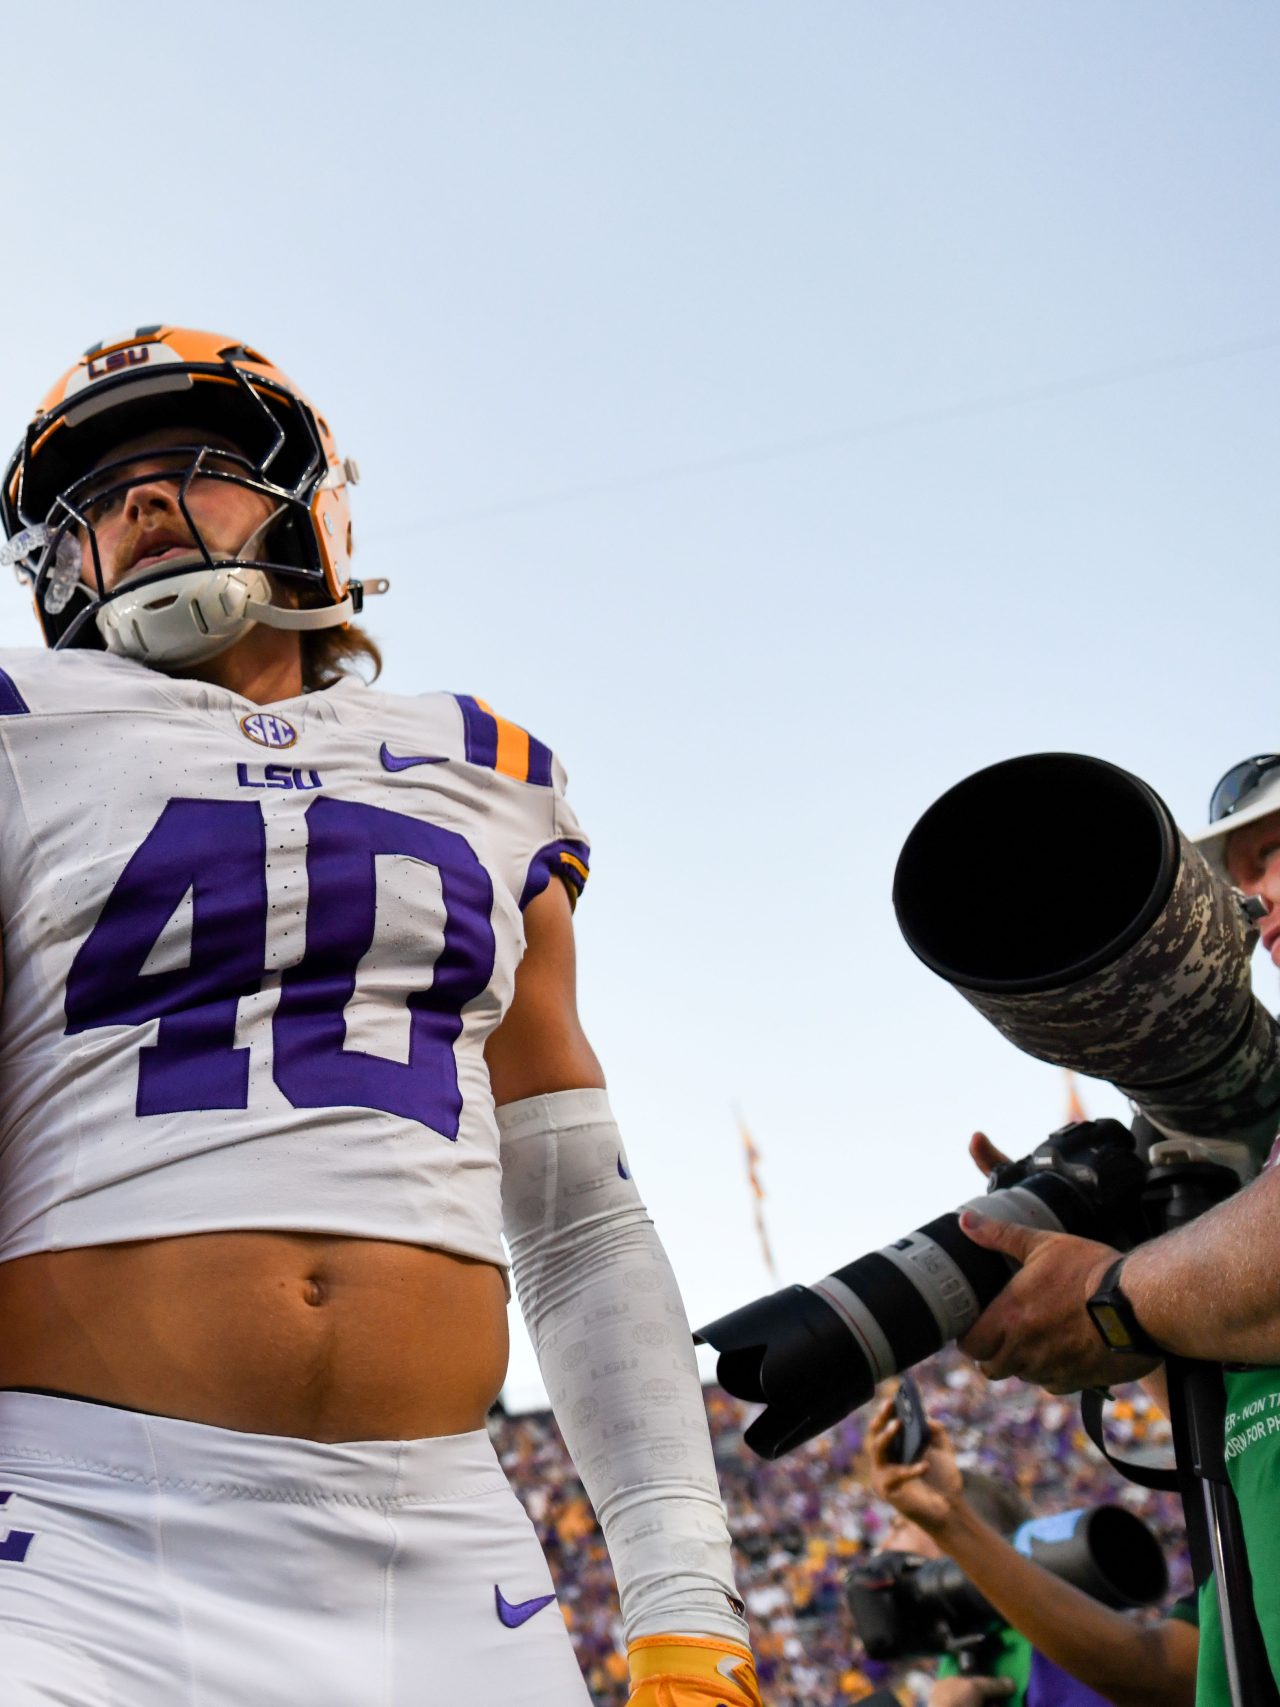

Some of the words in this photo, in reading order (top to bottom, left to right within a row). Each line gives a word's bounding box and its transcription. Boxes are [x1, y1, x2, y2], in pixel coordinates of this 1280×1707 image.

[88, 347, 150, 380] LSU
[243, 713, 294, 747] SEC
[236, 762, 322, 790] LSU
[64, 796, 495, 1141] 40
[1243, 1397, 1267, 1420] NON
[1246, 1421, 1266, 1445] FOR
